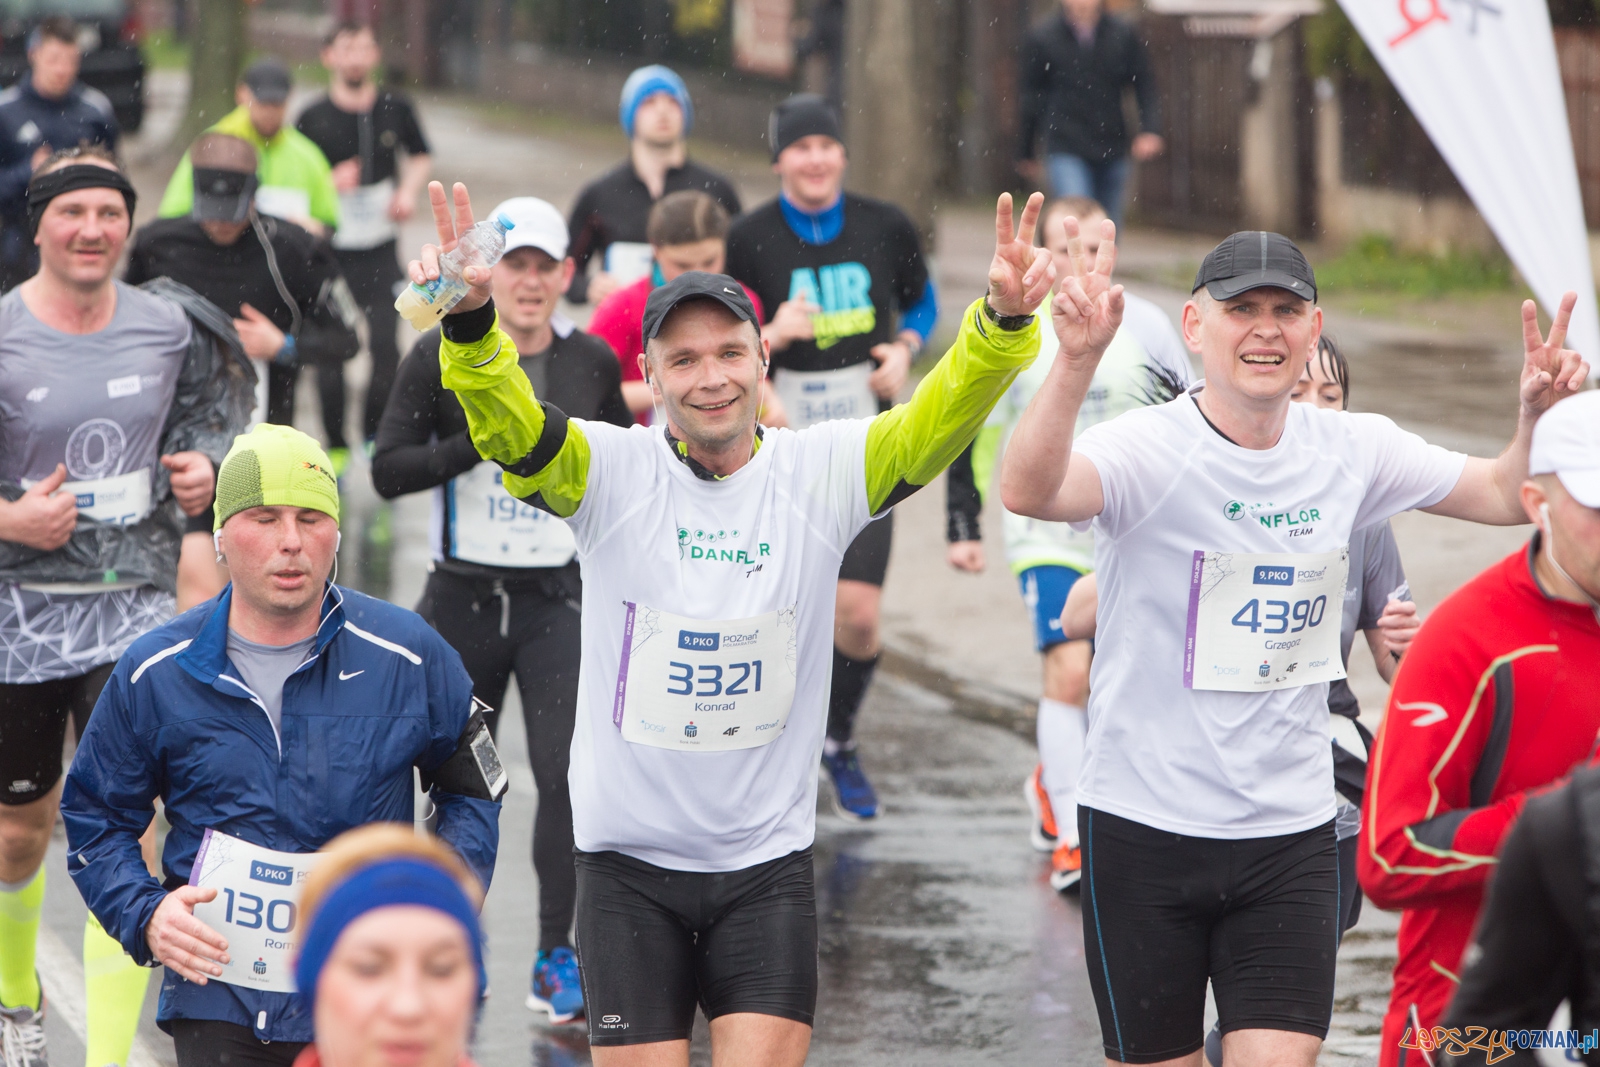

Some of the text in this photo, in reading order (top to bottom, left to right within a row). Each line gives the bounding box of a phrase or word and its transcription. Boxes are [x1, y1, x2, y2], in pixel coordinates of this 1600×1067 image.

[788, 261, 874, 314] AIR
[1288, 527, 1313, 537] TEAM
[691, 543, 770, 565] DANFLR
[1231, 594, 1327, 634] 4390
[1264, 638, 1301, 650] Grzegorz
[667, 660, 762, 697] 3321
[694, 701, 736, 712] Konrad
[723, 726, 740, 736] 4F
